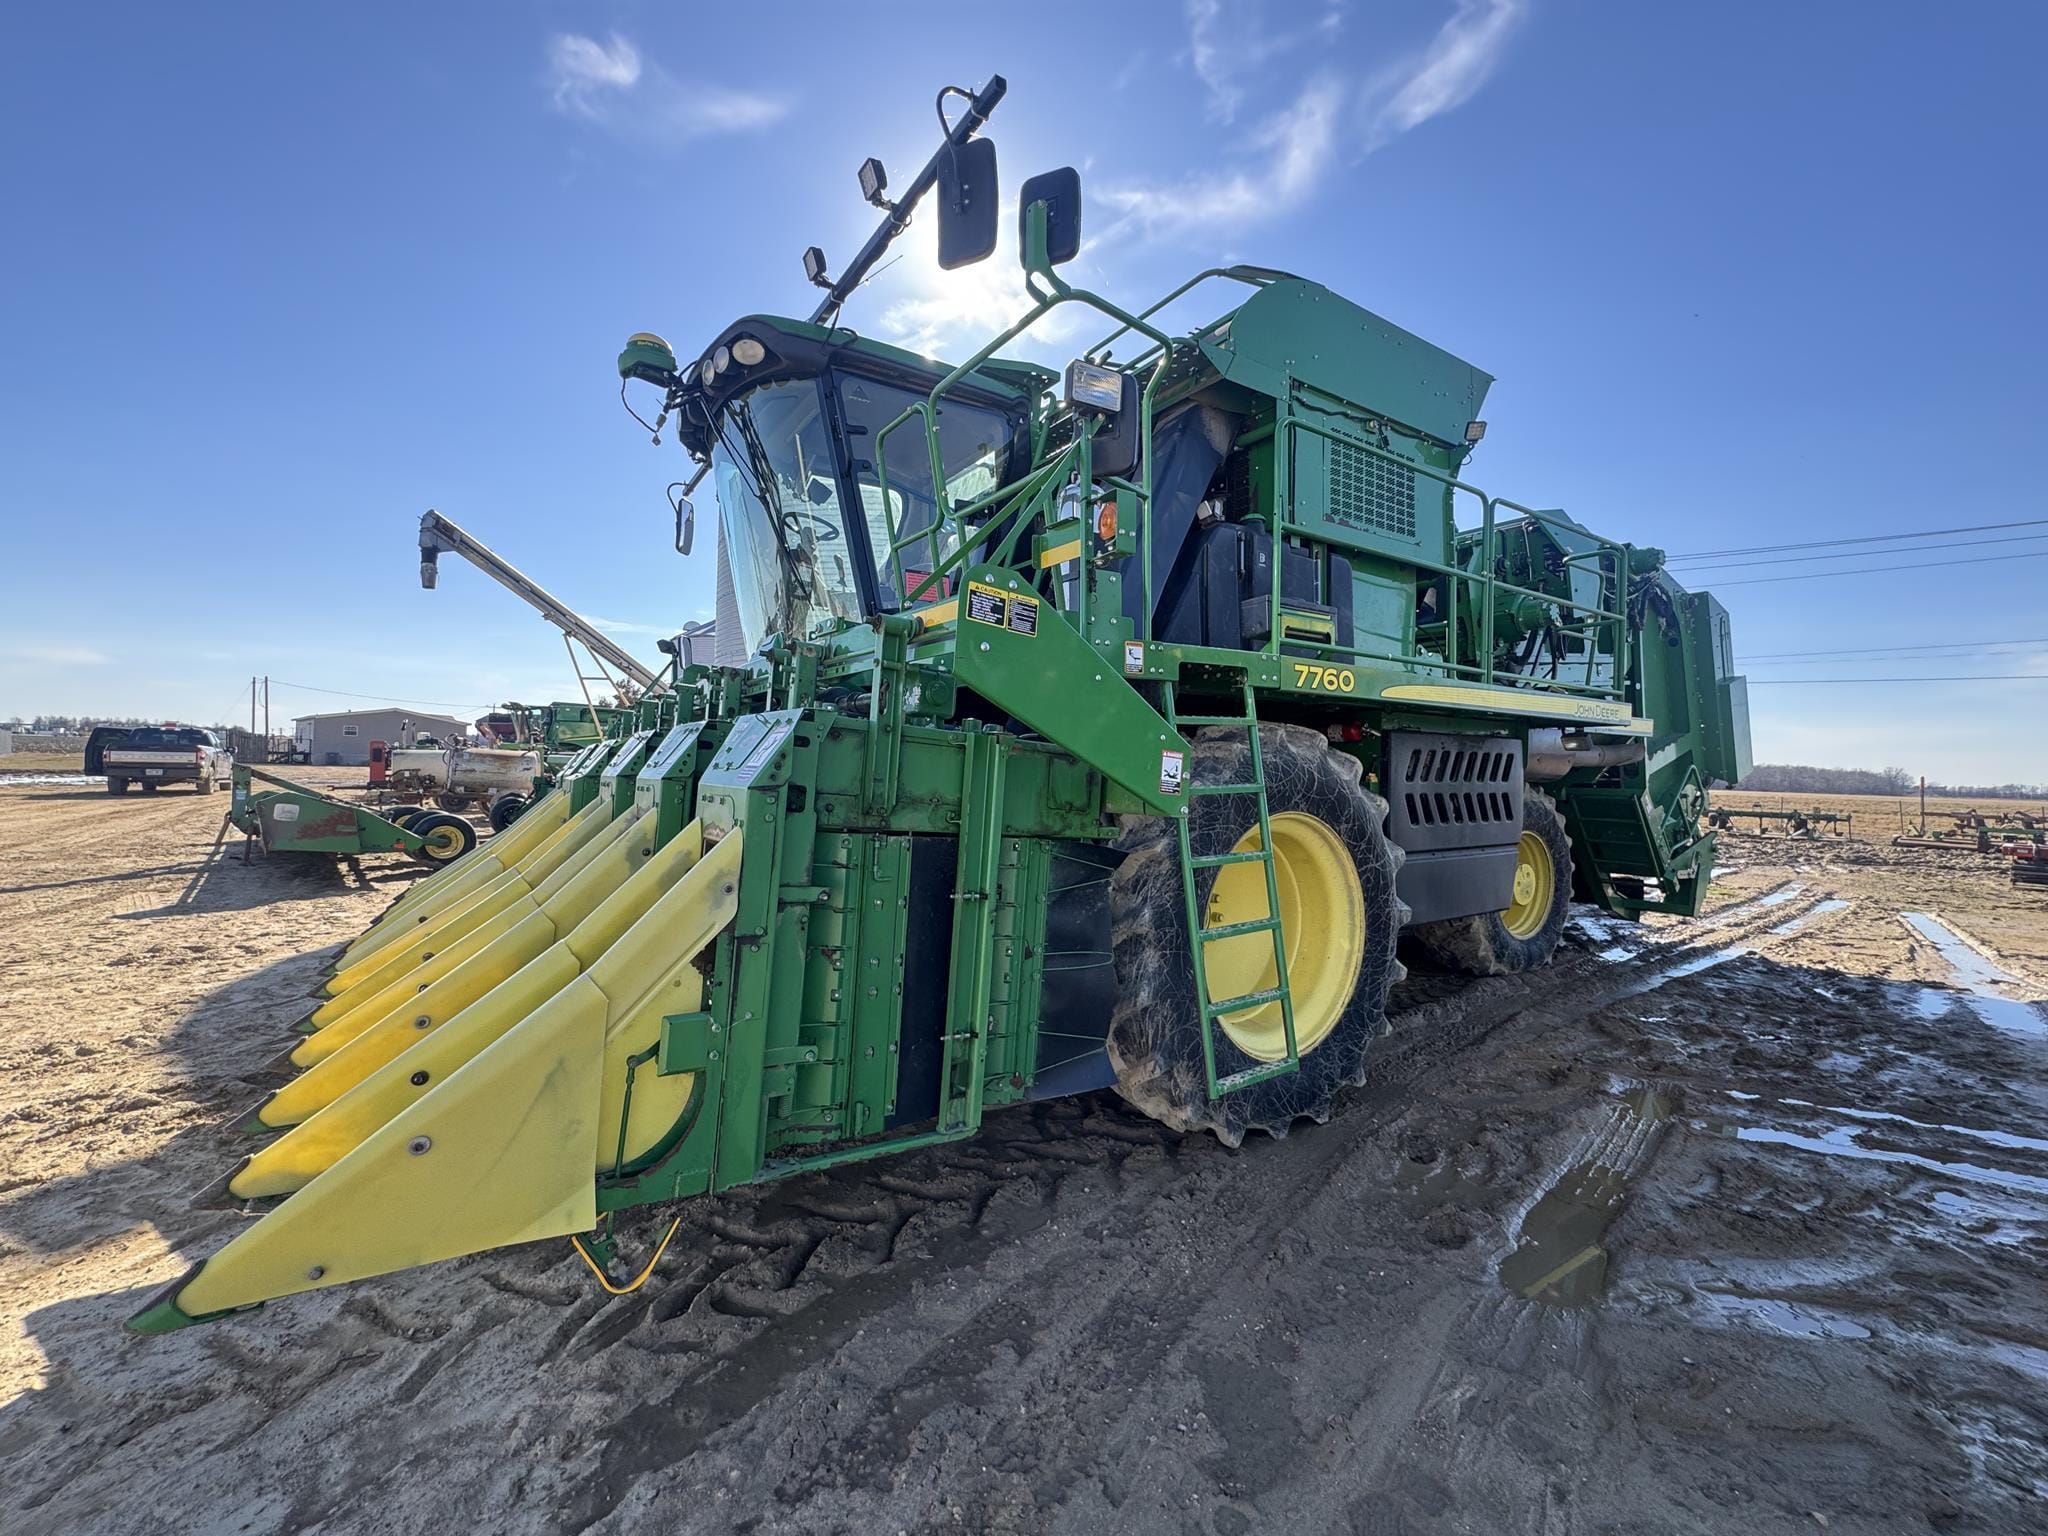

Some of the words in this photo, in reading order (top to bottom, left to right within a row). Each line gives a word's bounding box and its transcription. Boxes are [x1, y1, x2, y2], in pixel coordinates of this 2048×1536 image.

[980, 586, 1002, 596] CAUTION
[1294, 663, 1355, 692] 7760
[1574, 703, 1595, 716] JOHN
[1595, 704, 1619, 719] DEERE
